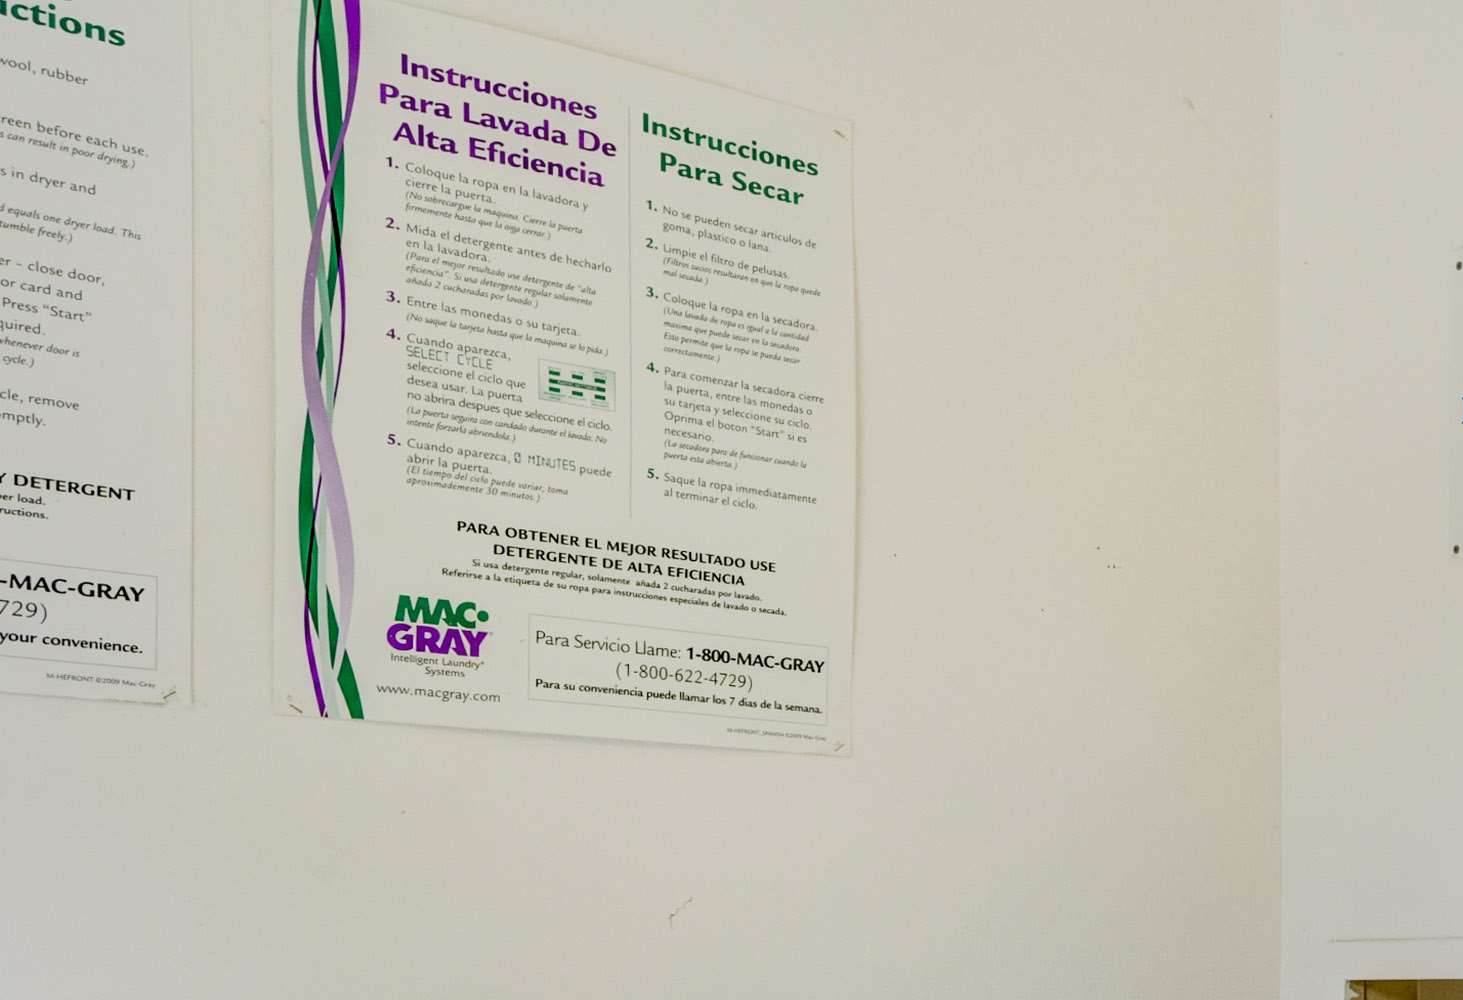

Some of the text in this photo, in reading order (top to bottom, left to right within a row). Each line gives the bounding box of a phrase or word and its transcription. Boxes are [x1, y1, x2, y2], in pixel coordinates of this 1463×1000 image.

[40, 67, 89, 86] rubber
[401, 53, 597, 120] Instrucciones
[379, 83, 617, 157] Para Lavada De
[1, 116, 148, 157] reen before each use.
[6, 133, 26, 143] can
[27, 138, 57, 151] result
[59, 145, 70, 153] in
[71, 147, 95, 158] poor
[642, 112, 818, 176] Instrucciones
[393, 122, 605, 187] Alta Eficiencia
[11, 166, 25, 180] in
[28, 171, 67, 189] dryer
[69, 183, 96, 196] and
[405, 162, 589, 212] Coloque la ropa en la lavadora y
[405, 177, 496, 204] cierre la puerta.
[660, 152, 804, 205] Para Secar
[7, 207, 41, 220] equals
[42, 214, 62, 224] one
[63, 216, 91, 231] dryer
[121, 228, 141, 241] This
[406, 223, 612, 273] Mida el detergente antes de hecharlo
[0, 278, 83, 301] or card and
[27, 261, 63, 277] close
[66, 268, 105, 287] door,
[2, 296, 92, 322] Press “Start”
[406, 361, 526, 390] seleccione el ciclo que
[28, 395, 80, 411] remove
[13, 474, 135, 501] DETERGENT
[17, 493, 46, 506] load.
[663, 472, 817, 505] Saque la ropa immediatamente
[663, 487, 758, 510] al terminar el ciclo.
[457, 520, 776, 573] PARA OBTENER EL MEJOR RESULTADO USE
[472, 558, 481, 567] Si
[483, 562, 499, 570] usa
[501, 562, 549, 576] detergente
[551, 570, 585, 581] regular,
[587, 573, 631, 585] solamente
[635, 579, 661, 589] añada
[663, 582, 669, 590] 2
[670, 584, 716, 596] cucharadas
[493, 544, 745, 586] DETERGENTE DE ALTA EFICIENCIA
[42, 636, 143, 654] convenience.
[386, 623, 488, 658] GRAY
[536, 630, 825, 674] Para Servicio Llame: 1-800-MAC-GRAY
[390, 653, 439, 666] Intelligent
[424, 667, 465, 678] Systems
[616, 662, 753, 693] (1-800-622-4729)
[376, 685, 501, 704] www.macgray.com
[535, 678, 561, 690] Para
[563, 683, 576, 691] su
[578, 684, 644, 697] conveniencia
[646, 690, 677, 701] puede
[679, 691, 710, 703] llamar
[712, 694, 727, 705] los
[729, 696, 736, 705] 7
[760, 699, 772, 709] de
[774, 700, 783, 711] la
[785, 704, 823, 714] semana.
